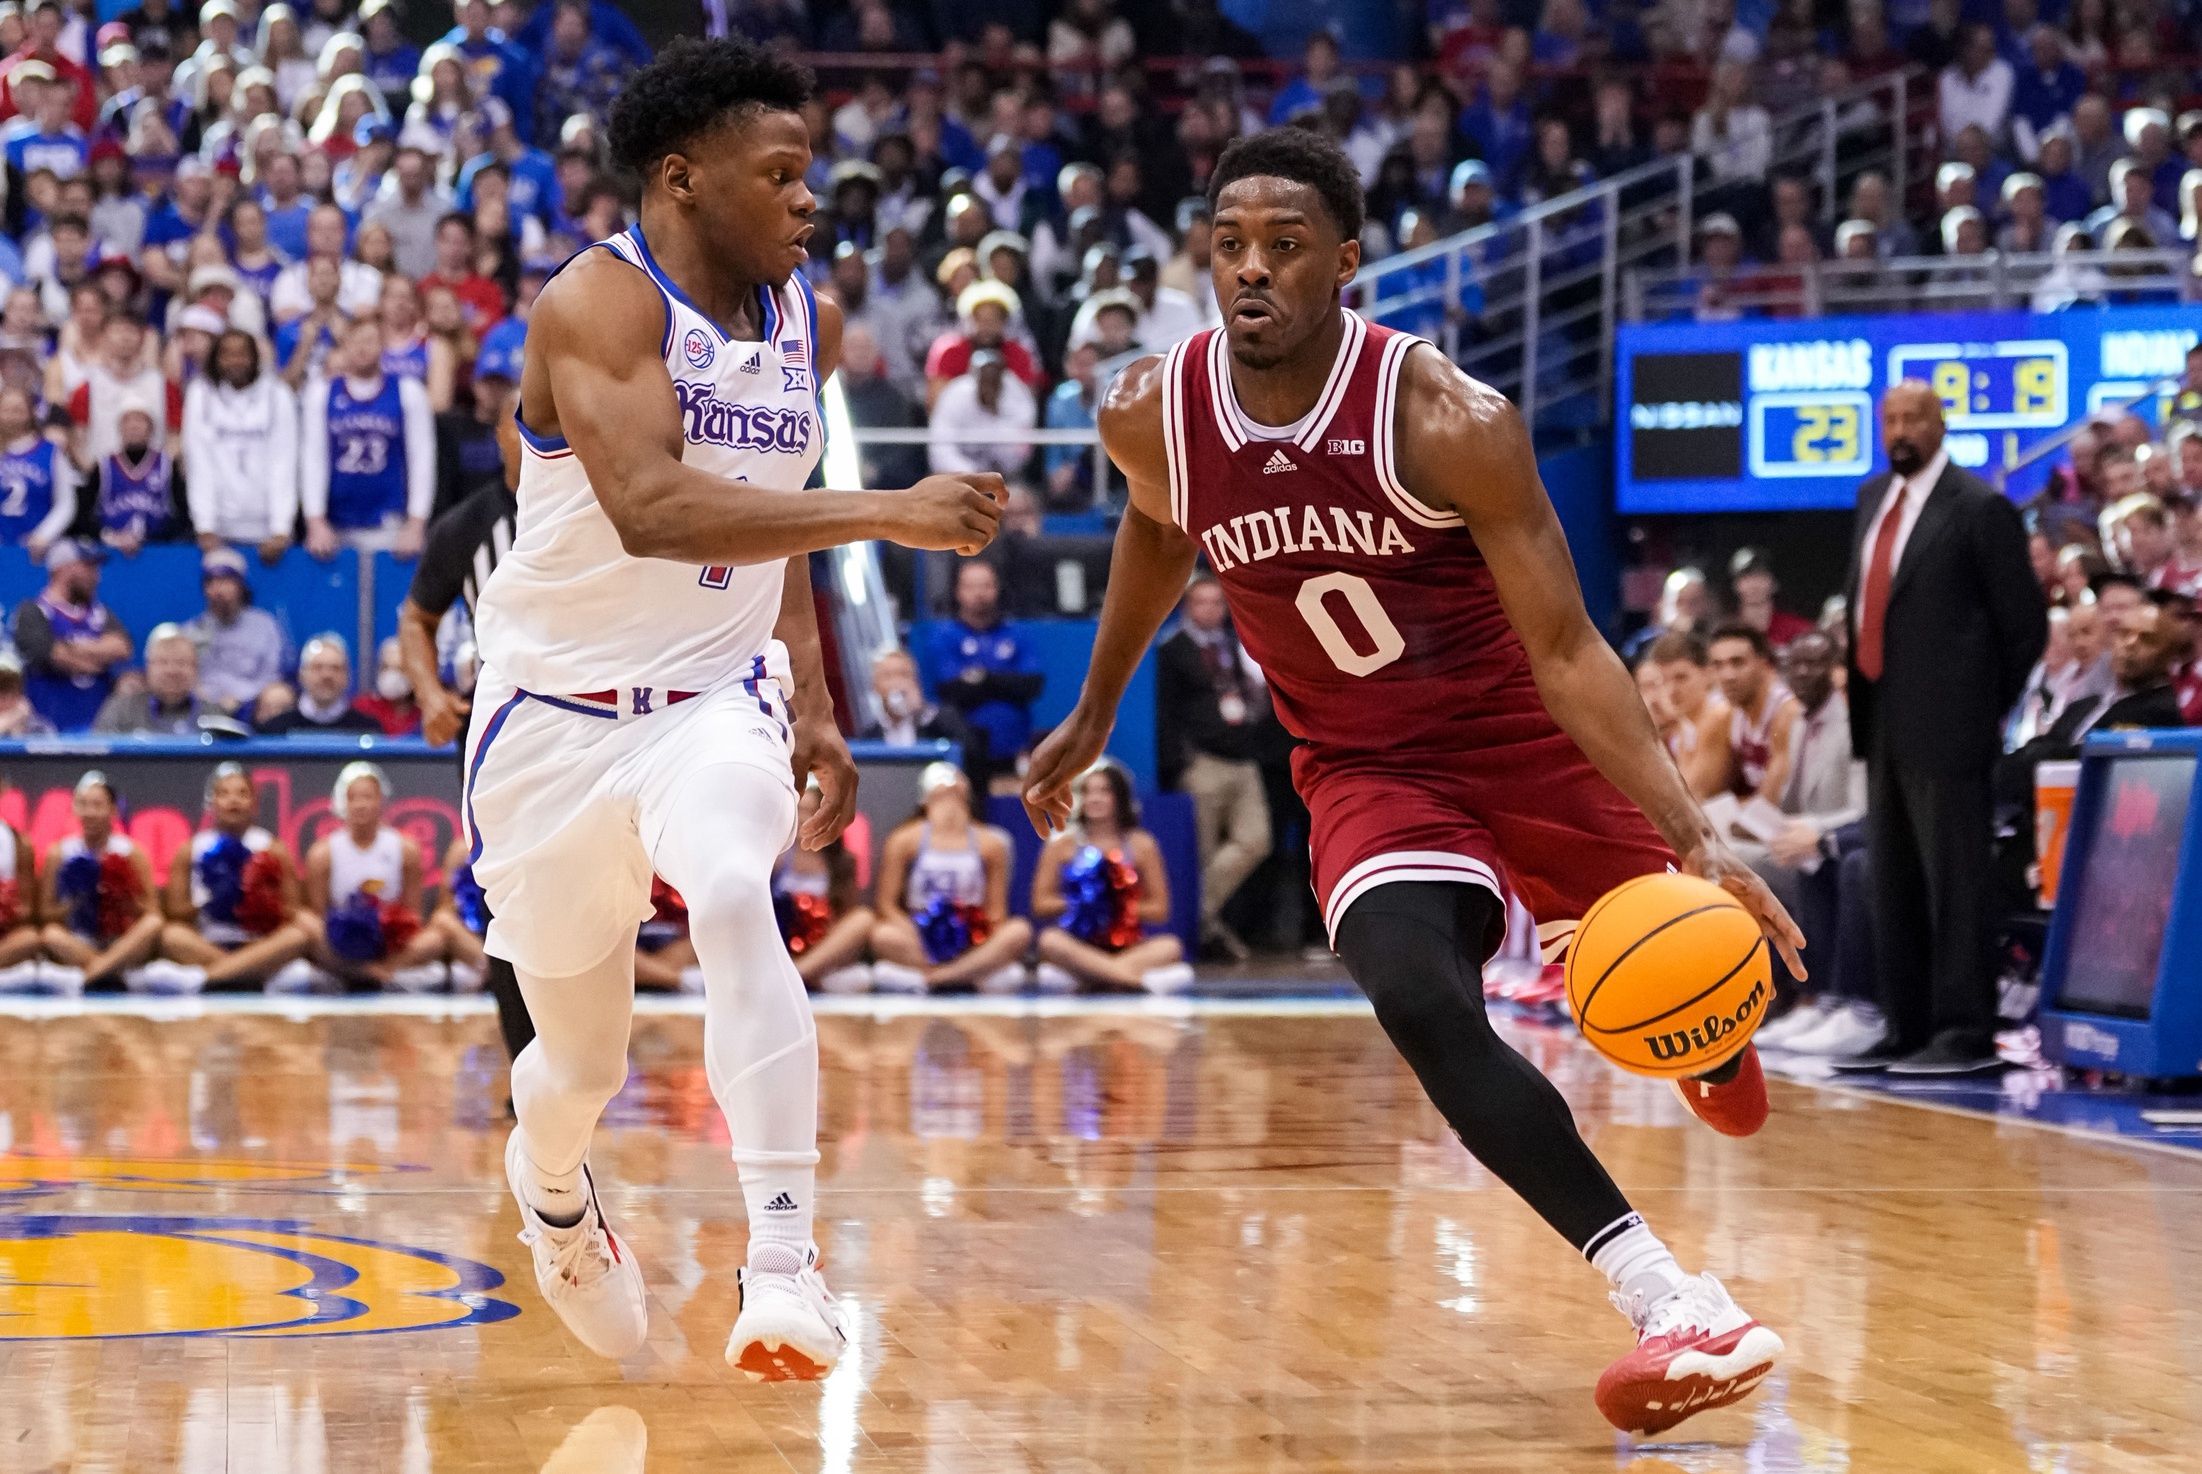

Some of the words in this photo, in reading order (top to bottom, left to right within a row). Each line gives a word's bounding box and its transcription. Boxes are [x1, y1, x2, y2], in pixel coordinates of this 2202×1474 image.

[687, 339, 703, 355] 125
[1750, 339, 1872, 390] KANSAS
[673, 379, 812, 457] Kansas
[1630, 402, 1742, 429] NISSAN
[1792, 405, 1859, 463] 23
[336, 436, 389, 474] 23
[1262, 462, 1298, 475] adidas
[1201, 504, 1416, 573] INDIANA
[1294, 570, 1407, 678] 0
[631, 686, 654, 715] K
[1643, 980, 1765, 1061] Wilson
[763, 1203, 798, 1212] adidas
